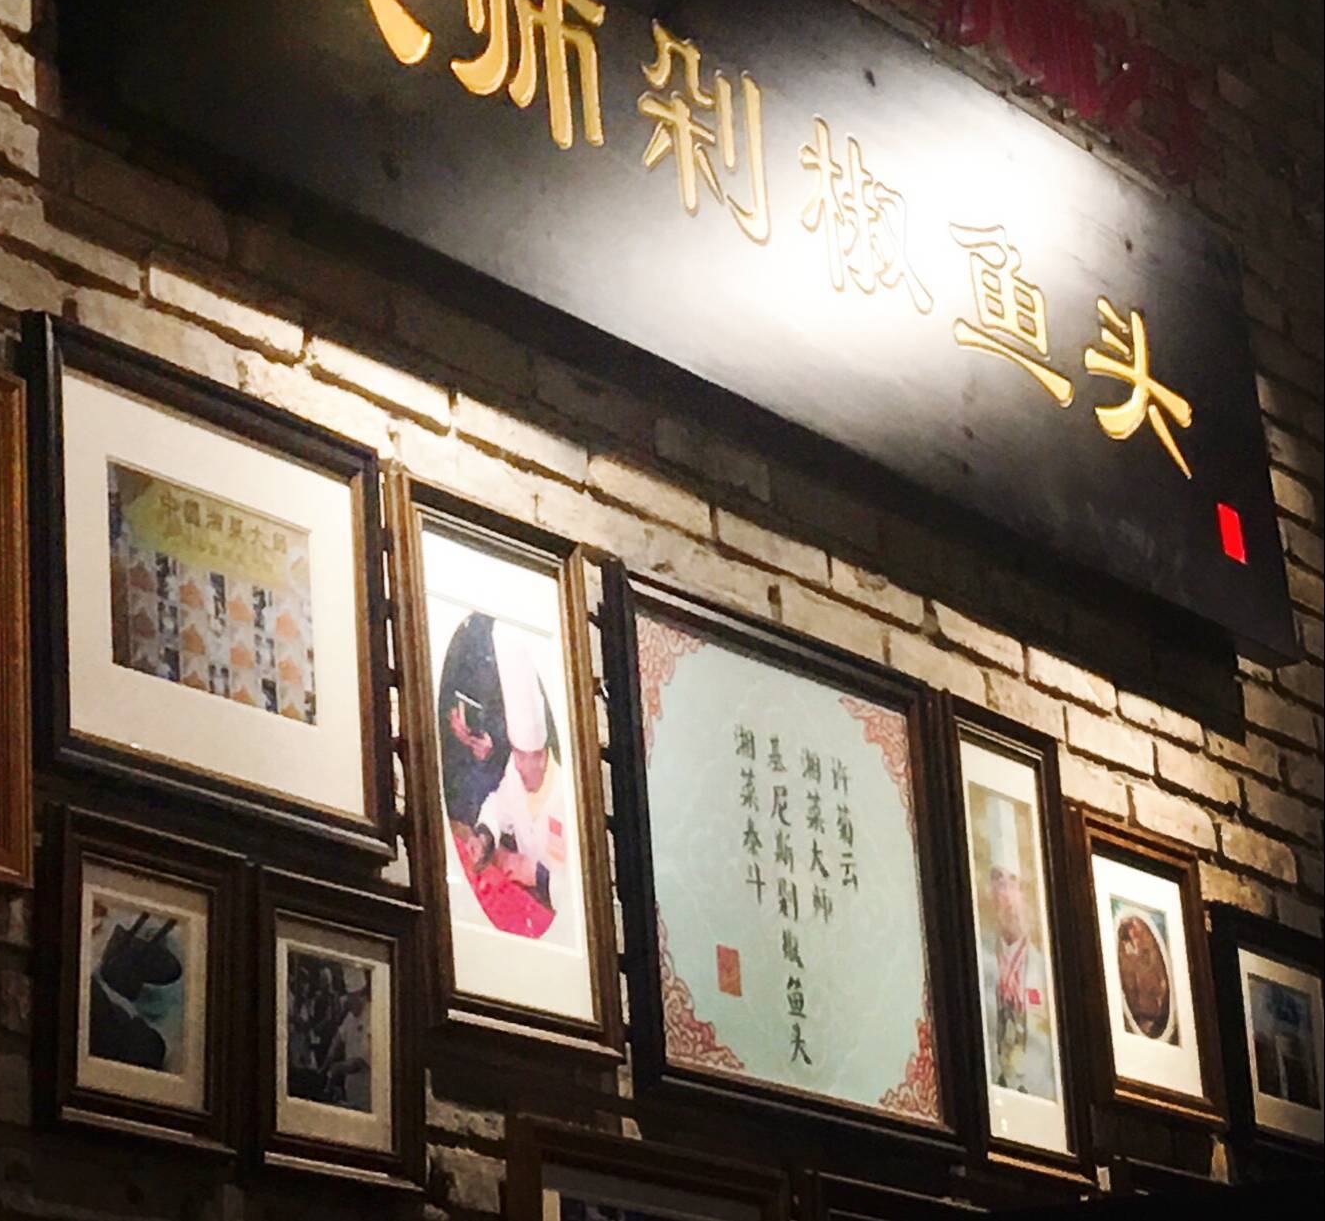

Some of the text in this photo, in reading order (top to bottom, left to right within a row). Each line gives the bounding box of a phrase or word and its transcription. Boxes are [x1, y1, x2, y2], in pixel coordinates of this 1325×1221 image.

[732, 723, 766, 906] 湘菜泰斗
[800, 747, 834, 924] 湘菜大师
